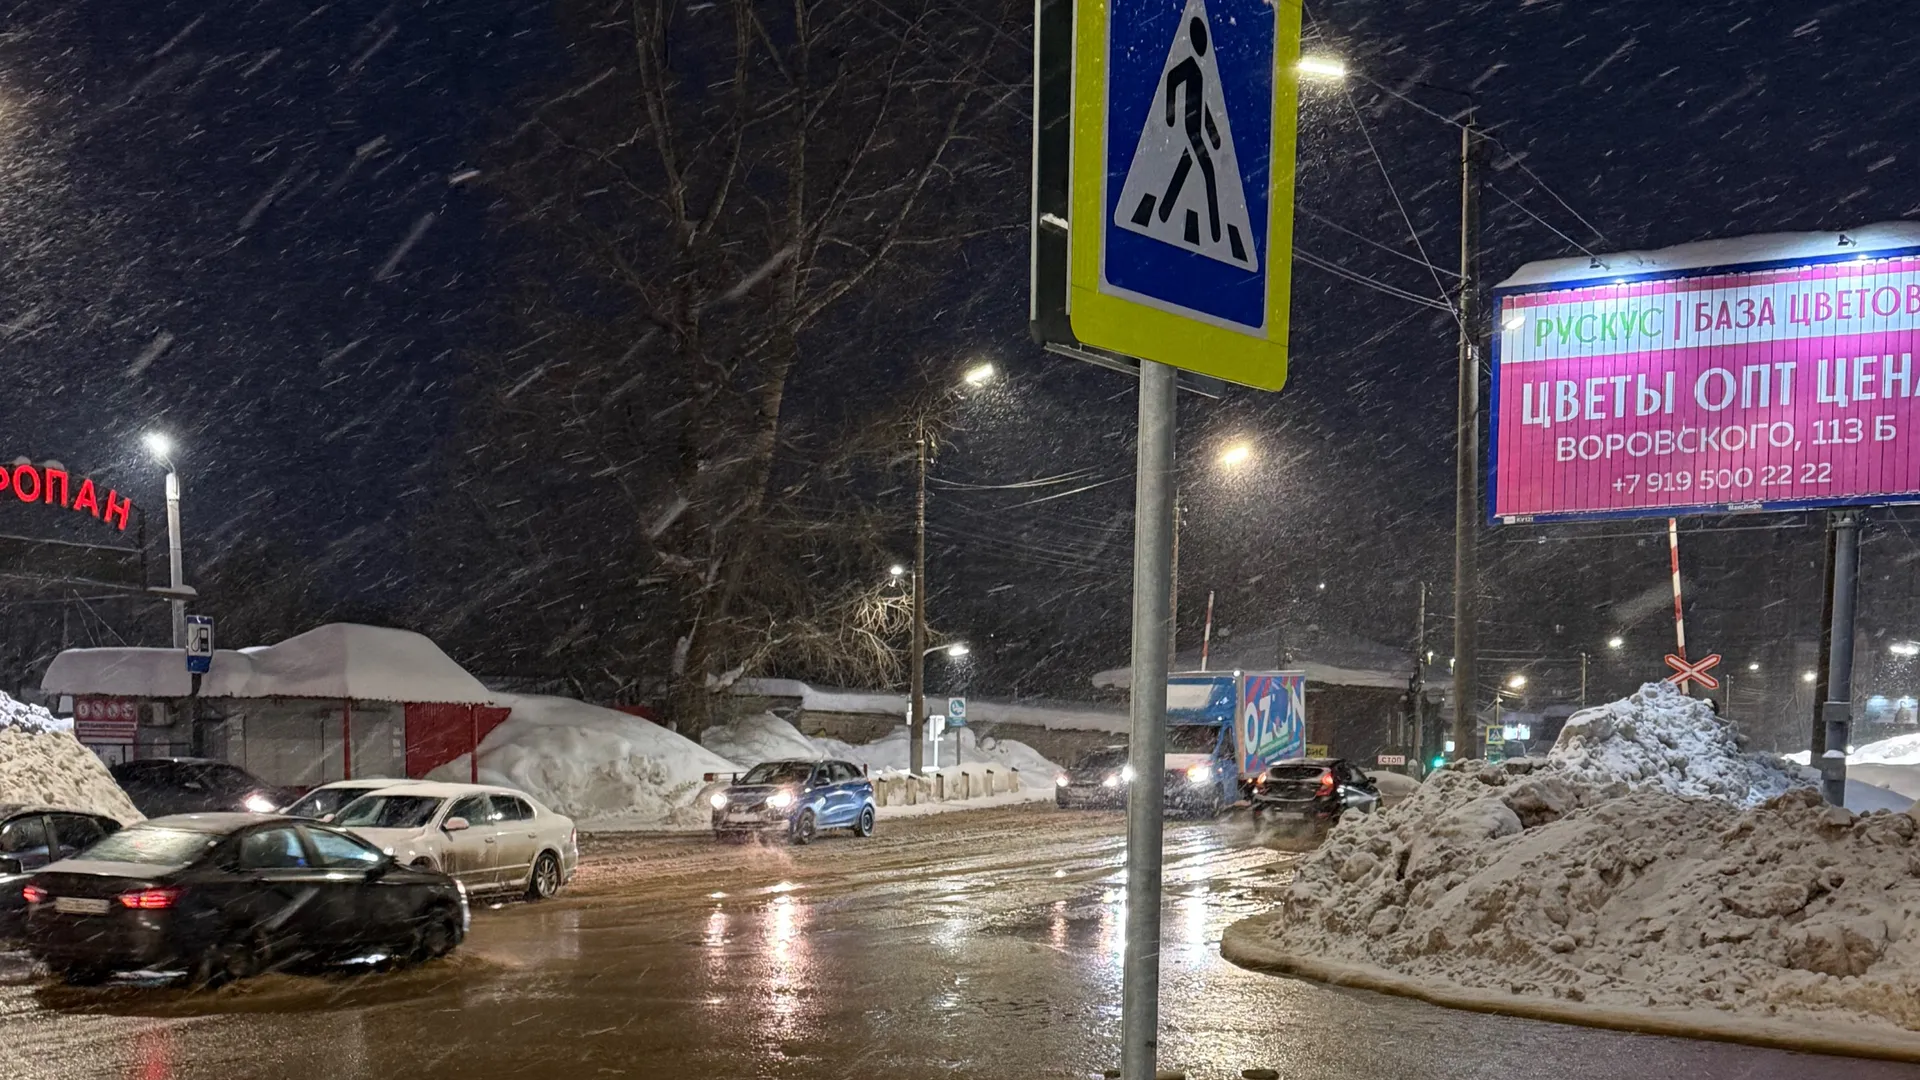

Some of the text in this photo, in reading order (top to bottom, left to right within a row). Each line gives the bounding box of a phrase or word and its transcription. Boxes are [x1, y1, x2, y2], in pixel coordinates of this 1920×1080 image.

[1535, 306, 1664, 347] РУСКУС
[1694, 284, 1920, 332] БАЗА ЦВЕТОВ
[1521, 352, 1920, 428] ЦВЕТЫ ОПТ ЦЕН
[1556, 415, 1897, 462] ВОРОВСКОГО, 113 Б
[1612, 462, 1832, 495] +7 919 500 22 22
